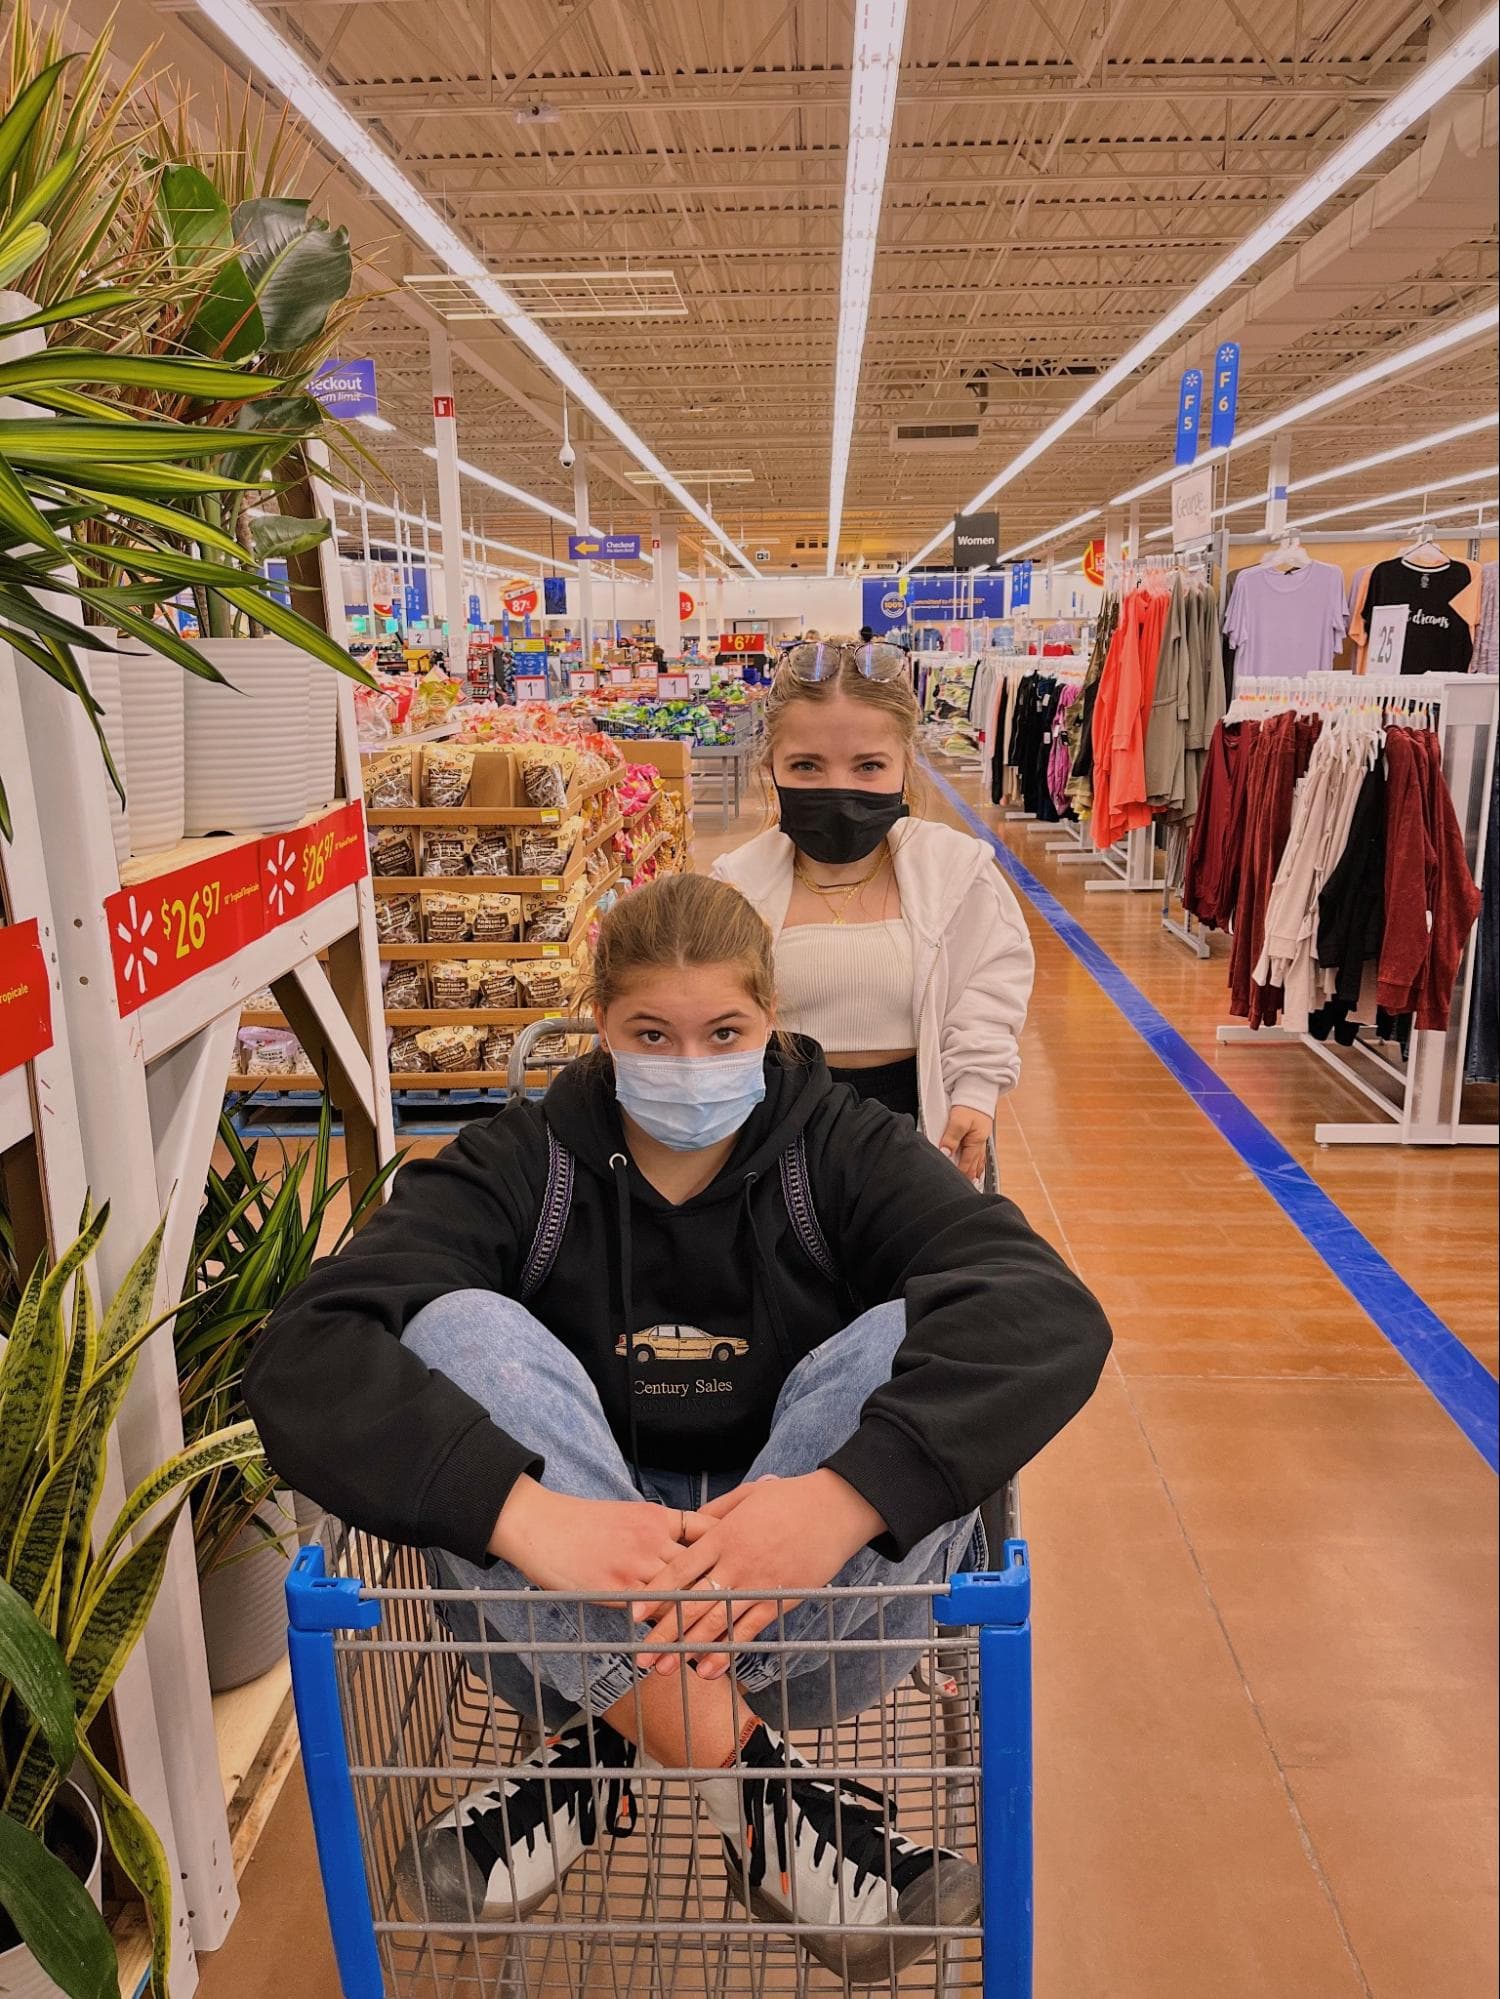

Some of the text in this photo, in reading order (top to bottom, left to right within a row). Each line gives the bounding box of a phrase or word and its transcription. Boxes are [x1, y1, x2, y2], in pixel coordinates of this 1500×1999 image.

[606, 541, 634, 549] Checkout
[957, 536, 995, 545] Women
[1412, 608, 1450, 629] dreams
[0, 983, 29, 1004] ropicale
[633, 1378, 733, 1398] Century Sales
